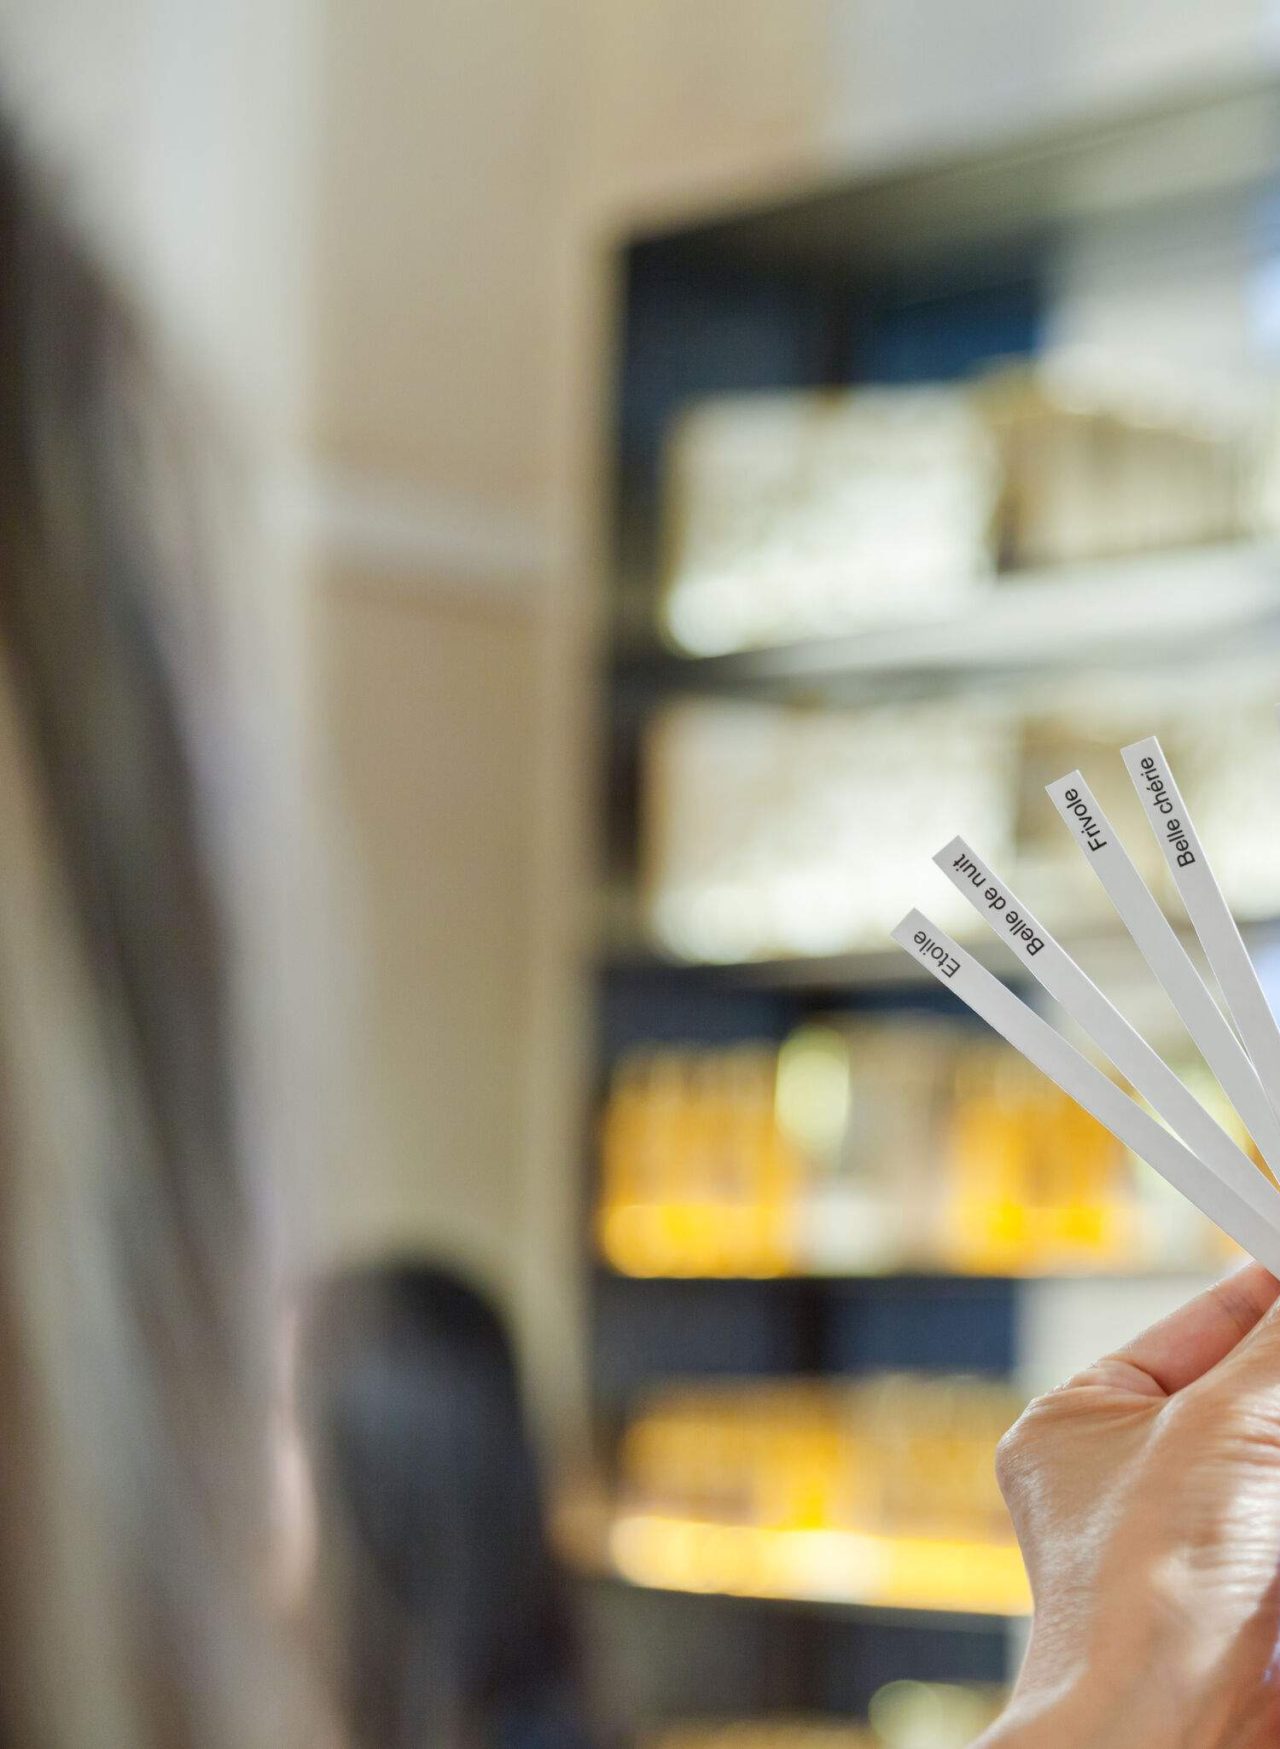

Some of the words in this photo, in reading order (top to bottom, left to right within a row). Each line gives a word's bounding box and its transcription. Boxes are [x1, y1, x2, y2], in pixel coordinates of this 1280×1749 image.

[1140, 756, 1173, 814] chérie
[1064, 788, 1108, 852] Frivole
[1166, 818, 1196, 868] Belle
[952, 853, 986, 888] nuit
[984, 887, 1006, 910] de
[913, 930, 961, 978] Etoile
[1005, 910, 1045, 957] Belle
